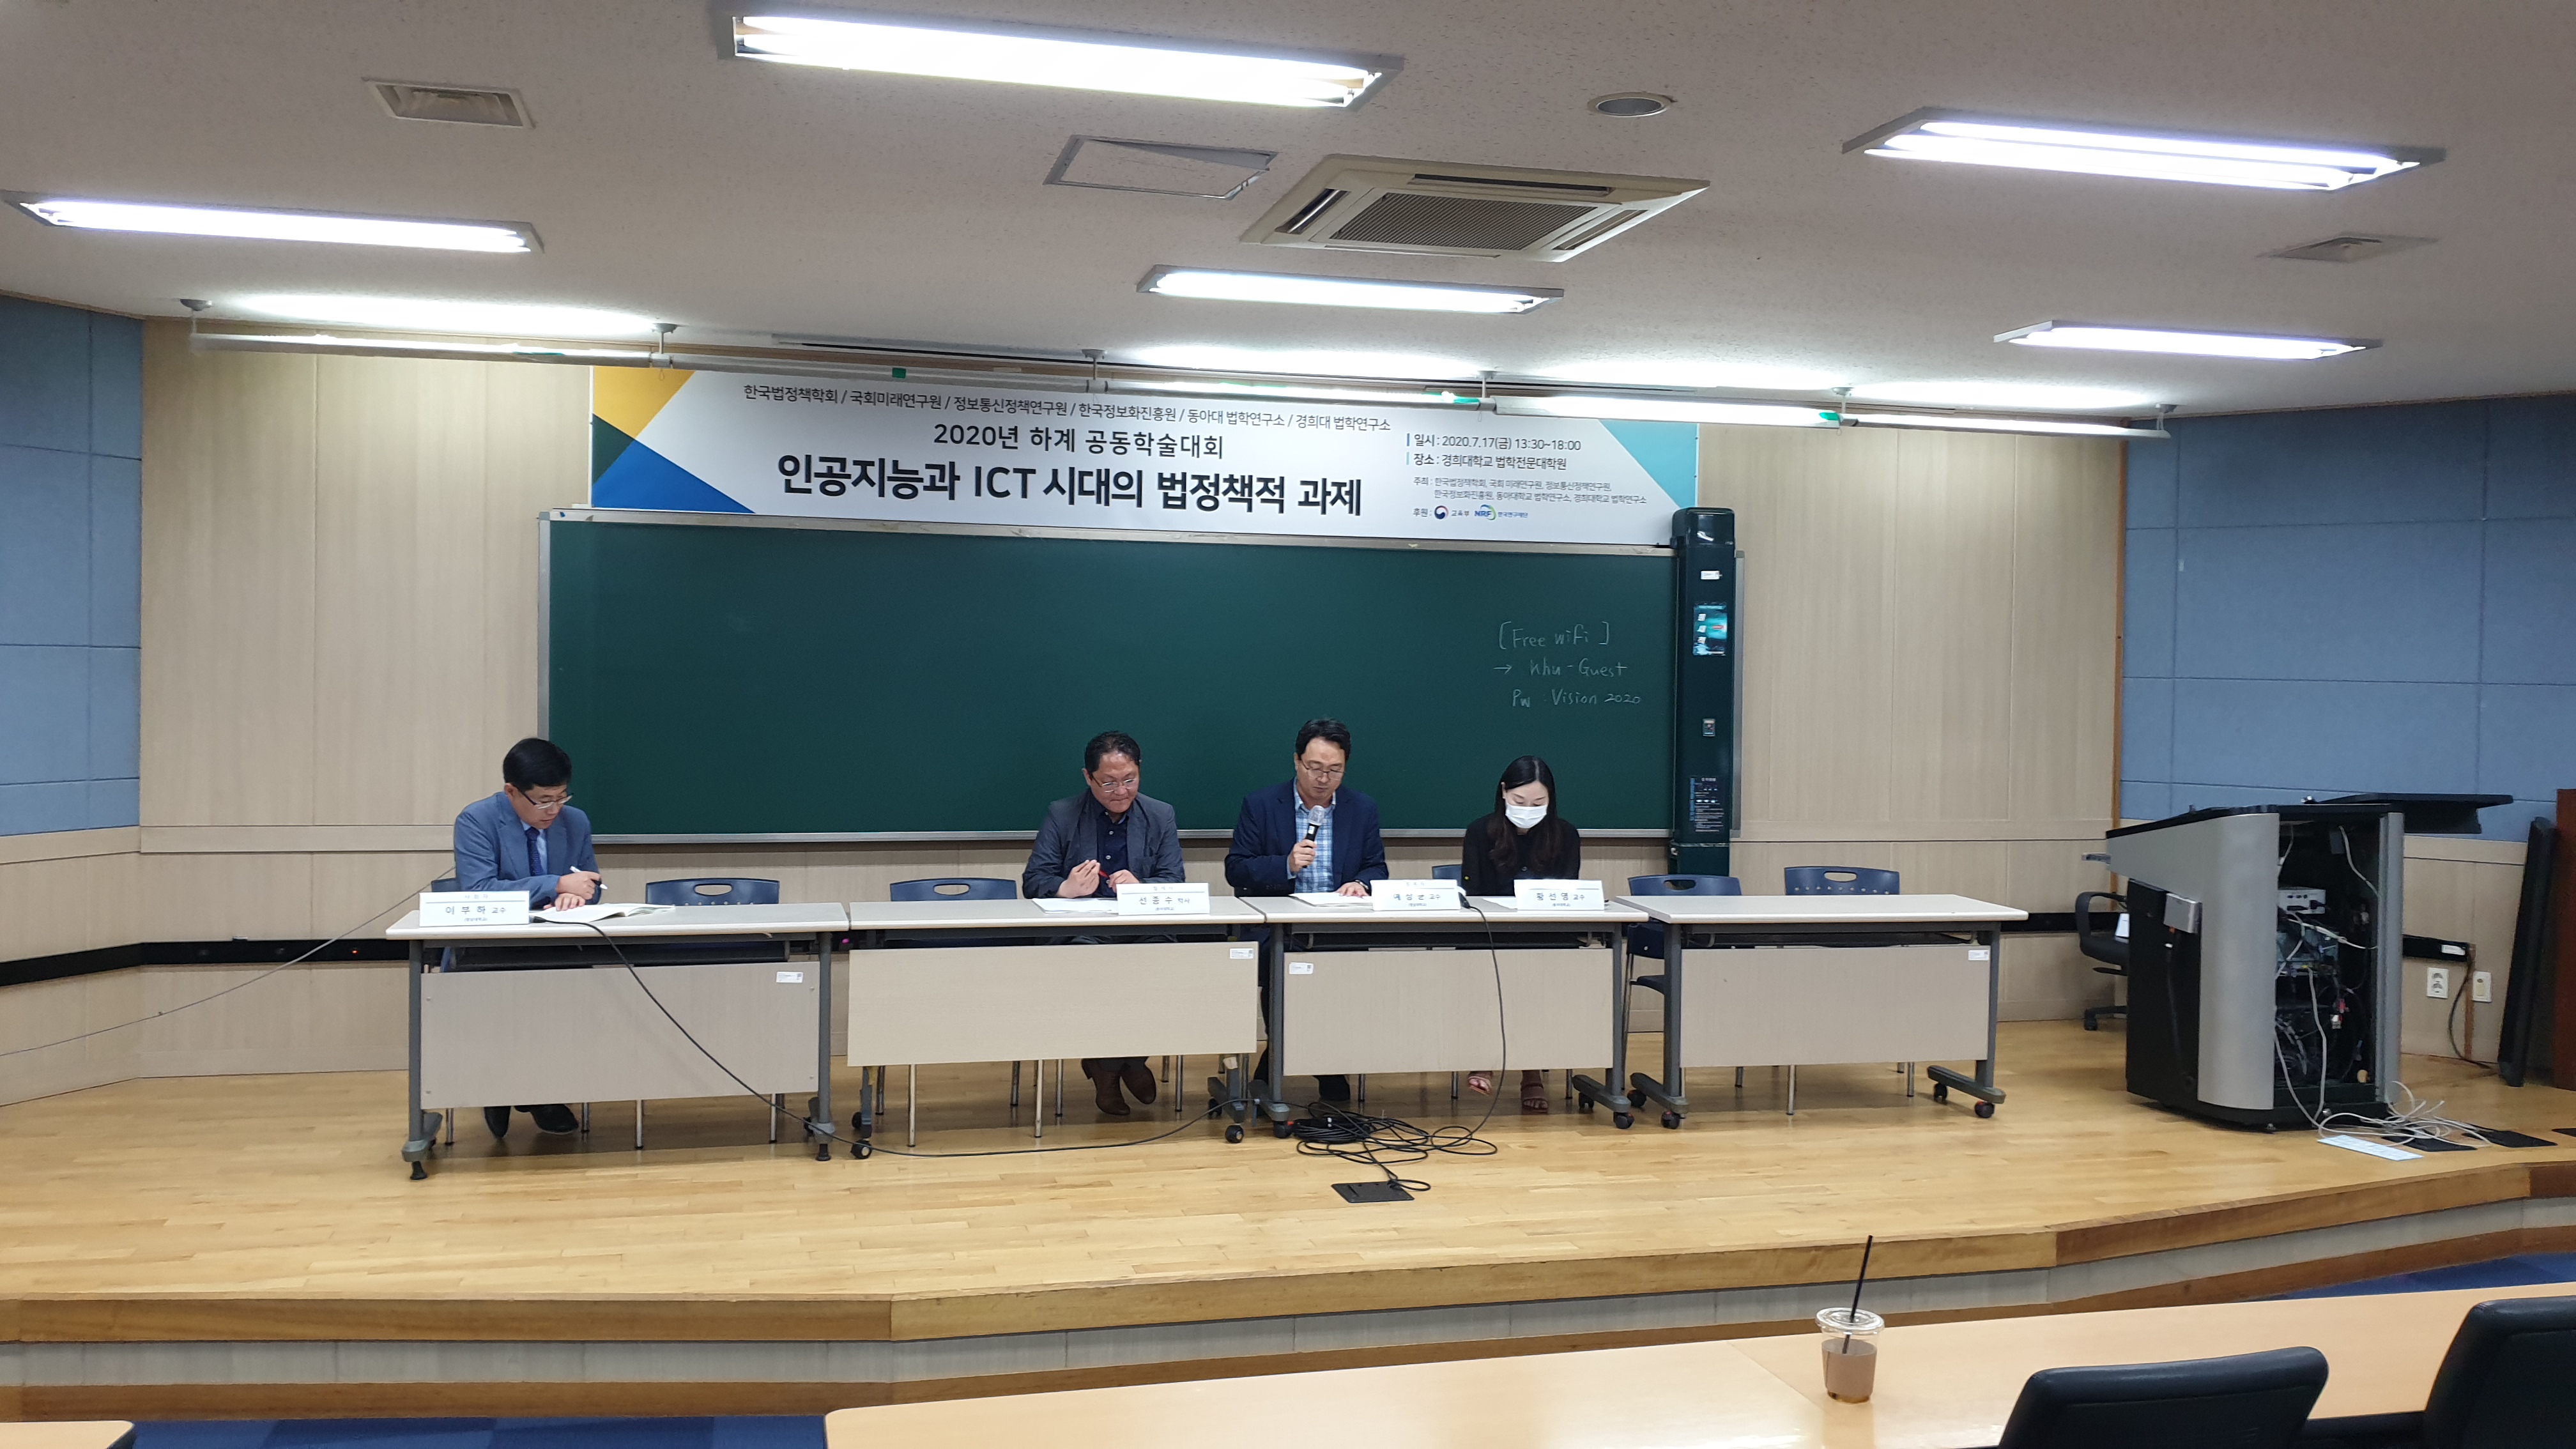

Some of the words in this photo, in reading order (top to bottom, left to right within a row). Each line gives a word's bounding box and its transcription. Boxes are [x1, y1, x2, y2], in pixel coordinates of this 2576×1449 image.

[744, 384, 838, 404] 한국법정책학회
[850, 390, 942, 410] 국회미래연구원
[954, 396, 1068, 417] 정보통신정책연구원
[1078, 403, 1176, 422] 한국정보화진흥원
[1187, 410, 1223, 424] 동아대
[1226, 412, 1285, 427] 법학연구소
[1296, 415, 1331, 429] 경희대
[1333, 417, 1392, 431] 법학연구소
[934, 424, 1019, 450] 2020년
[1030, 427, 1076, 452] 하계
[1085, 430, 1223, 459] 공동학술대회
[1414, 434, 1436, 447] 일시
[1442, 436, 1512, 450] 2020.7.17(금)
[1515, 438, 1582, 451] 13:30~18:00
[1414, 454, 1435, 466] 장소
[1442, 454, 1494, 468] 경희대학교
[1496, 456, 1567, 470] 법학전문대학원
[779, 454, 961, 501] 인공지능과
[974, 467, 1036, 500] ICT
[1043, 466, 1143, 509] 시대의
[1157, 470, 1287, 514] 법정책적
[1298, 477, 1363, 517] 과제
[1551, 688, 1598, 705] Vision
[1604, 693, 1642, 704] 2020
